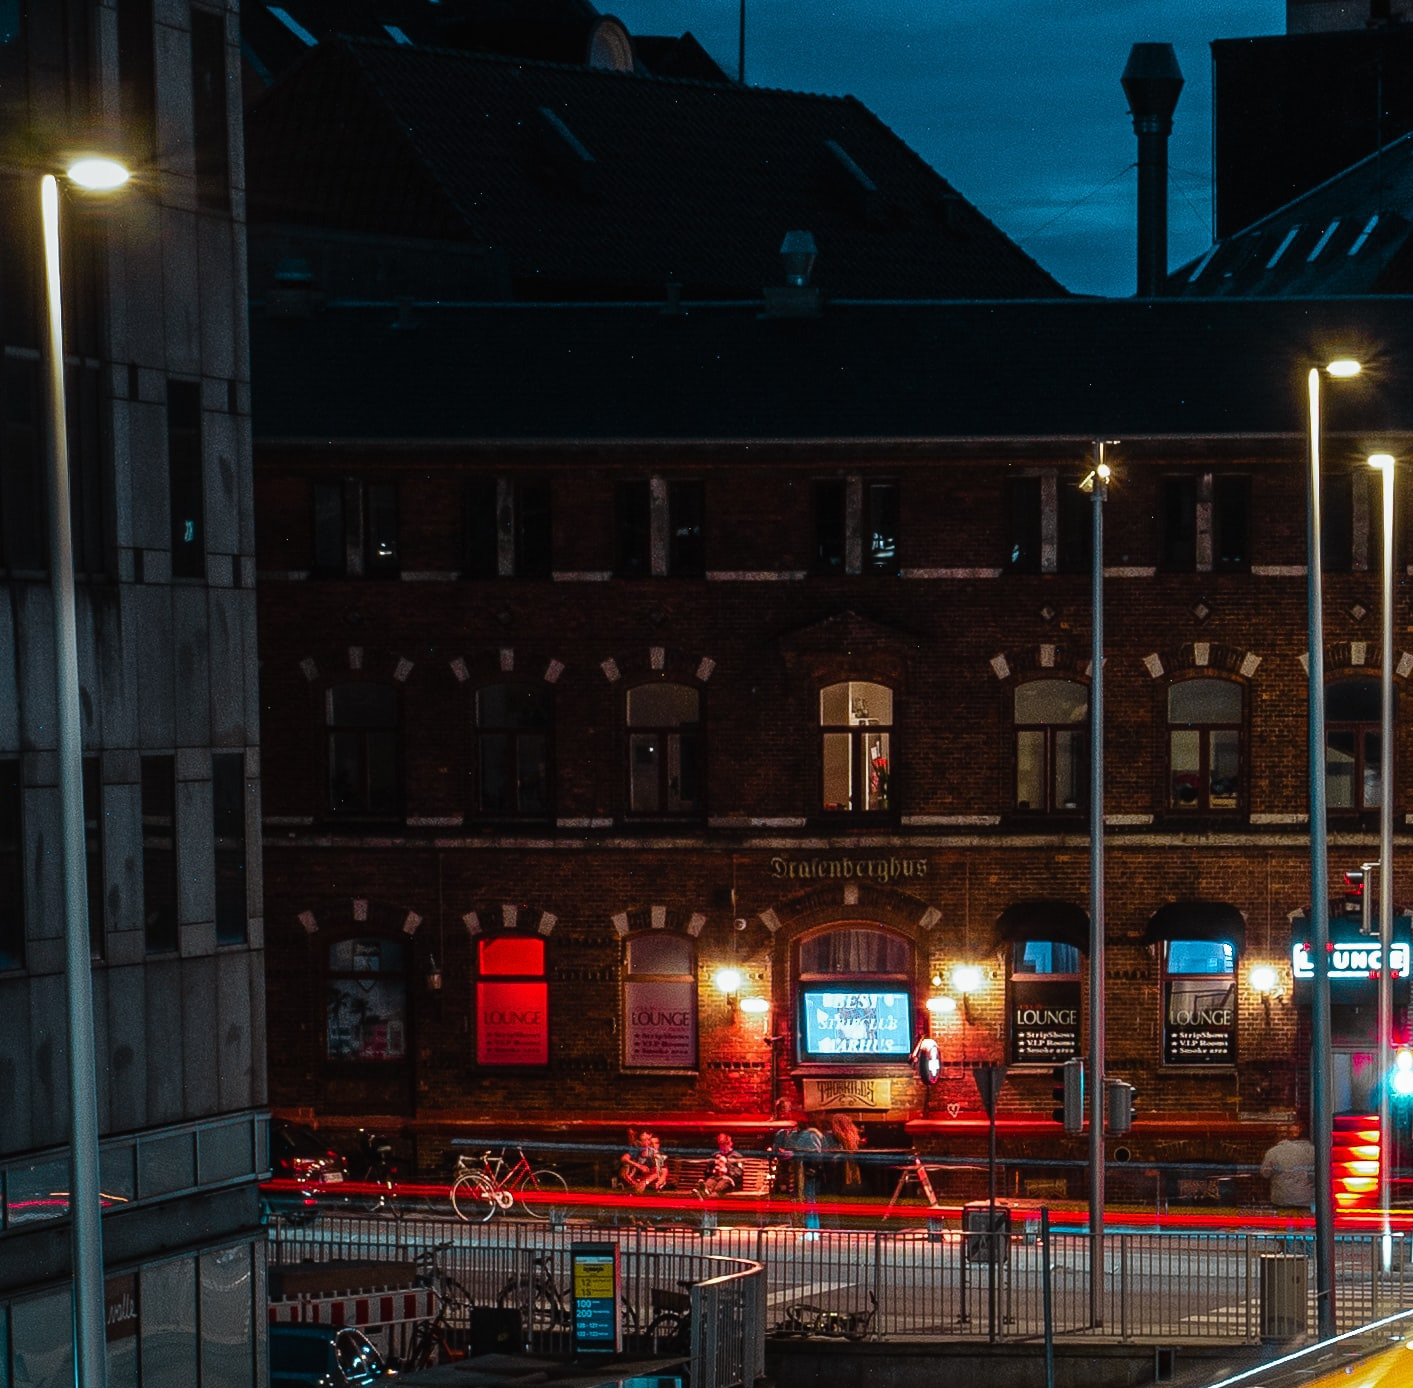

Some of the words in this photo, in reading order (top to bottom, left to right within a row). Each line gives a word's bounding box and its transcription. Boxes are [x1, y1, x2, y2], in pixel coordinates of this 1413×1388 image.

[1299, 950, 1404, 970] LUNGE
[484, 1011, 541, 1025] LOUNGE
[632, 1012, 690, 1026] LOUNGE
[1017, 1010, 1077, 1025] LOUNGE
[1170, 1010, 1231, 1025] LOUNGE
[1026, 1032, 1075, 1040] StripShows
[1179, 1032, 1228, 1040] StripShows
[577, 1300, 592, 1308] 100
[576, 1309, 592, 1318] 200
